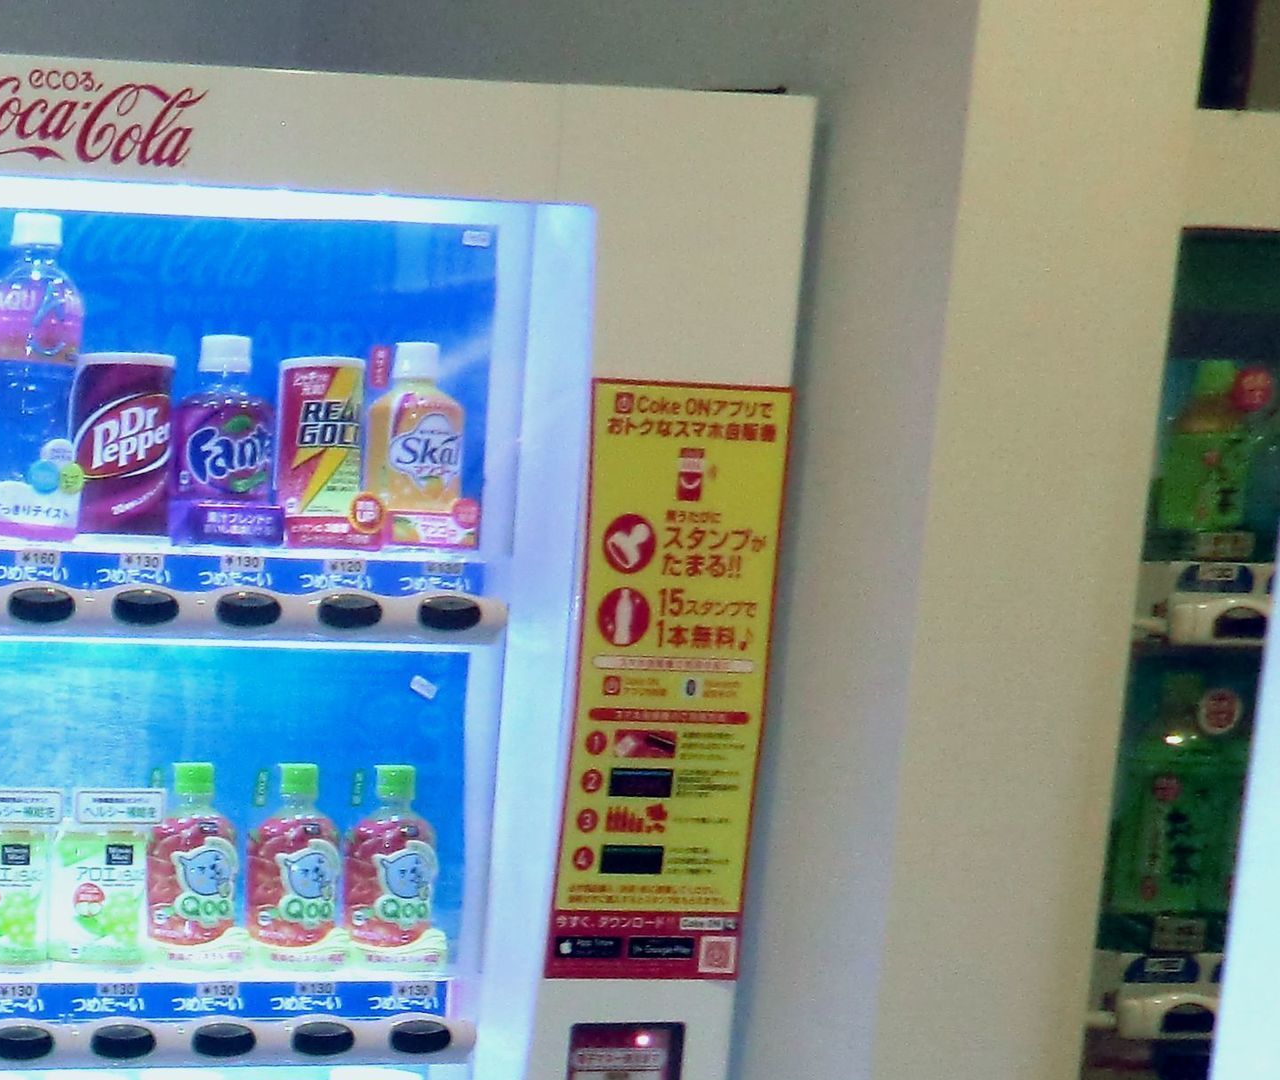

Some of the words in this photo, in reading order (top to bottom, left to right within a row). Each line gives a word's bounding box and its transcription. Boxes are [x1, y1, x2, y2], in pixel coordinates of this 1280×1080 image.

[302, 401, 359, 423] REA
[637, 396, 681, 415] Coke
[120, 406, 159, 438] Dr
[607, 417, 777, 443] おトクなスマホ自販機
[297, 423, 360, 448] GOL
[187, 425, 272, 485] Fant
[663, 527, 767, 551] スタンプが
[658, 588, 757, 618] 15スタンプで
[181, 896, 233, 916] Qoo
[285, 898, 335, 918] Qoo
[382, 898, 430, 919] Qoo
